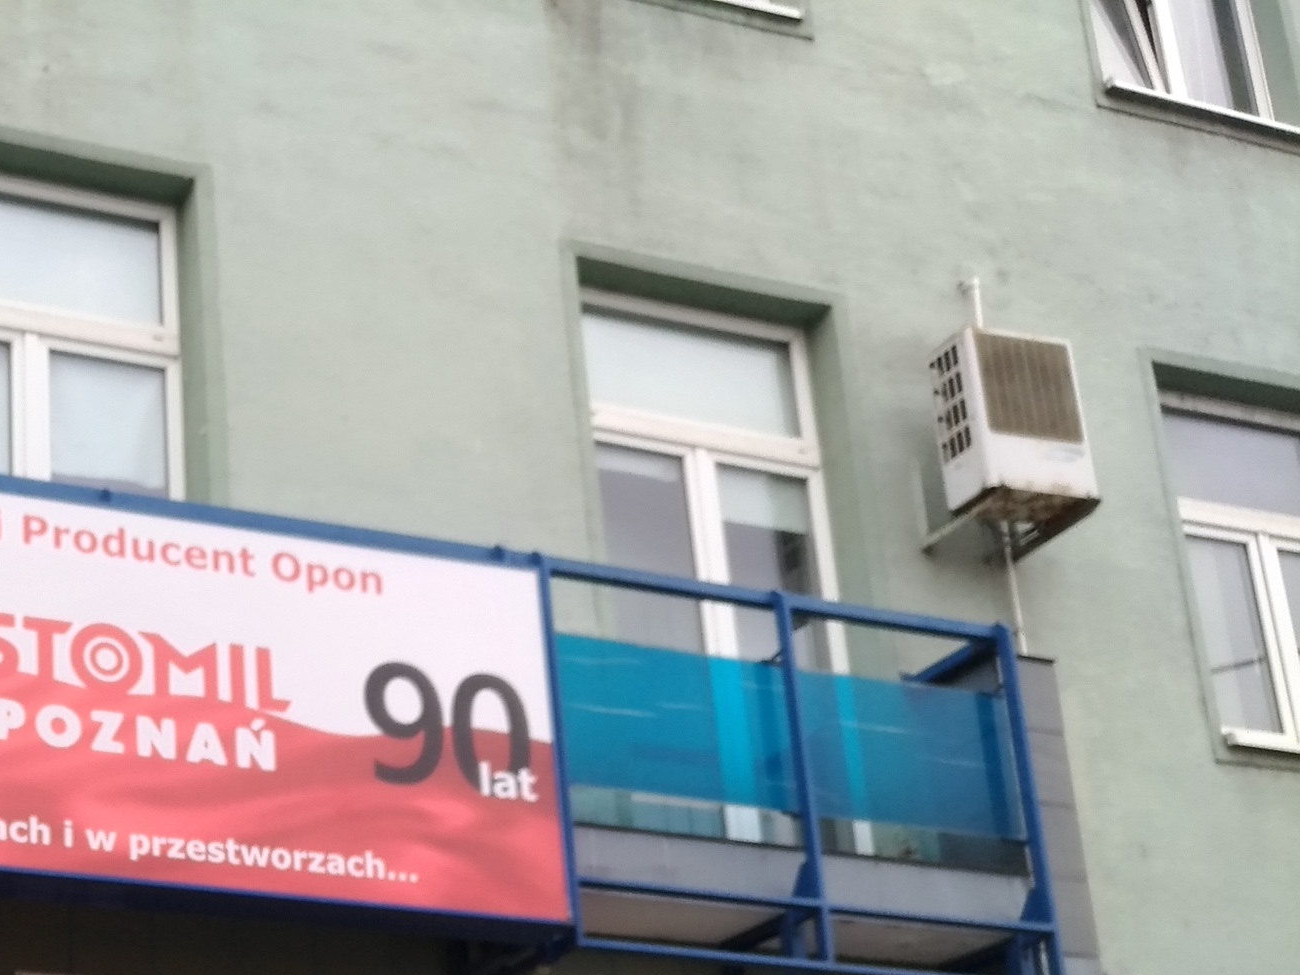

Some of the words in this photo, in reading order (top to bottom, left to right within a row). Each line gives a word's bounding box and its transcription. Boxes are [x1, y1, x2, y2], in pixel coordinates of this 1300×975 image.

[22, 514, 256, 578] Producent
[271, 552, 383, 595] Opon
[364, 661, 531, 795] 90
[478, 760, 539, 802] lat
[63, 819, 74, 848] i
[85, 828, 118, 853] w
[129, 832, 419, 884] przestworzach...
